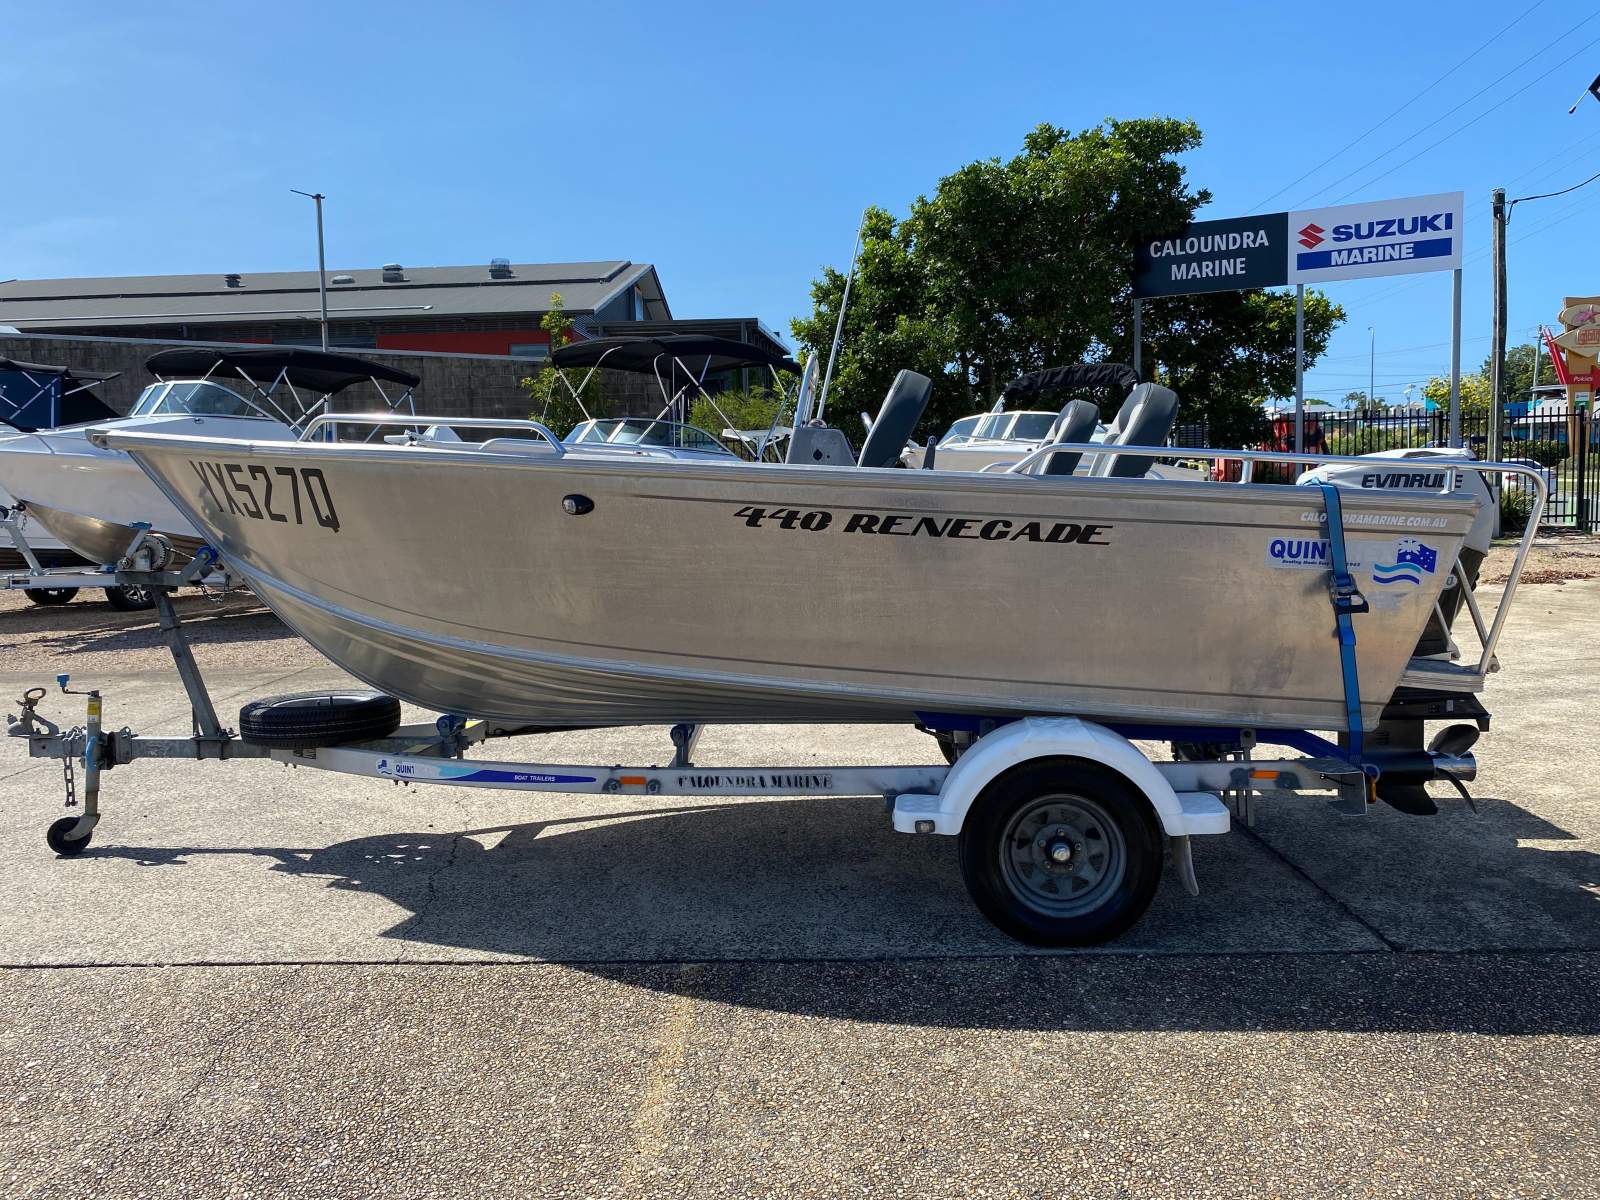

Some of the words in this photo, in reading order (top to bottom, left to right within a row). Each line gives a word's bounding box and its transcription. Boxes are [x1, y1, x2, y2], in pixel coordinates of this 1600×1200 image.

[1332, 212, 1453, 243] SUZUKI
[1150, 229, 1269, 258] CALOUNDRA
[1331, 243, 1415, 266] MARINE
[1171, 257, 1246, 281] MARINE
[188, 460, 340, 533] YX527Q
[734, 506, 832, 532] 440
[843, 513, 1113, 546] RENEGADE
[1301, 511, 1448, 529] CALODRAMARINE.COM.AU
[1270, 539, 1331, 560] QUIN
[678, 775, 767, 789] CALOUNDRA
[770, 774, 833, 788] MARINE
